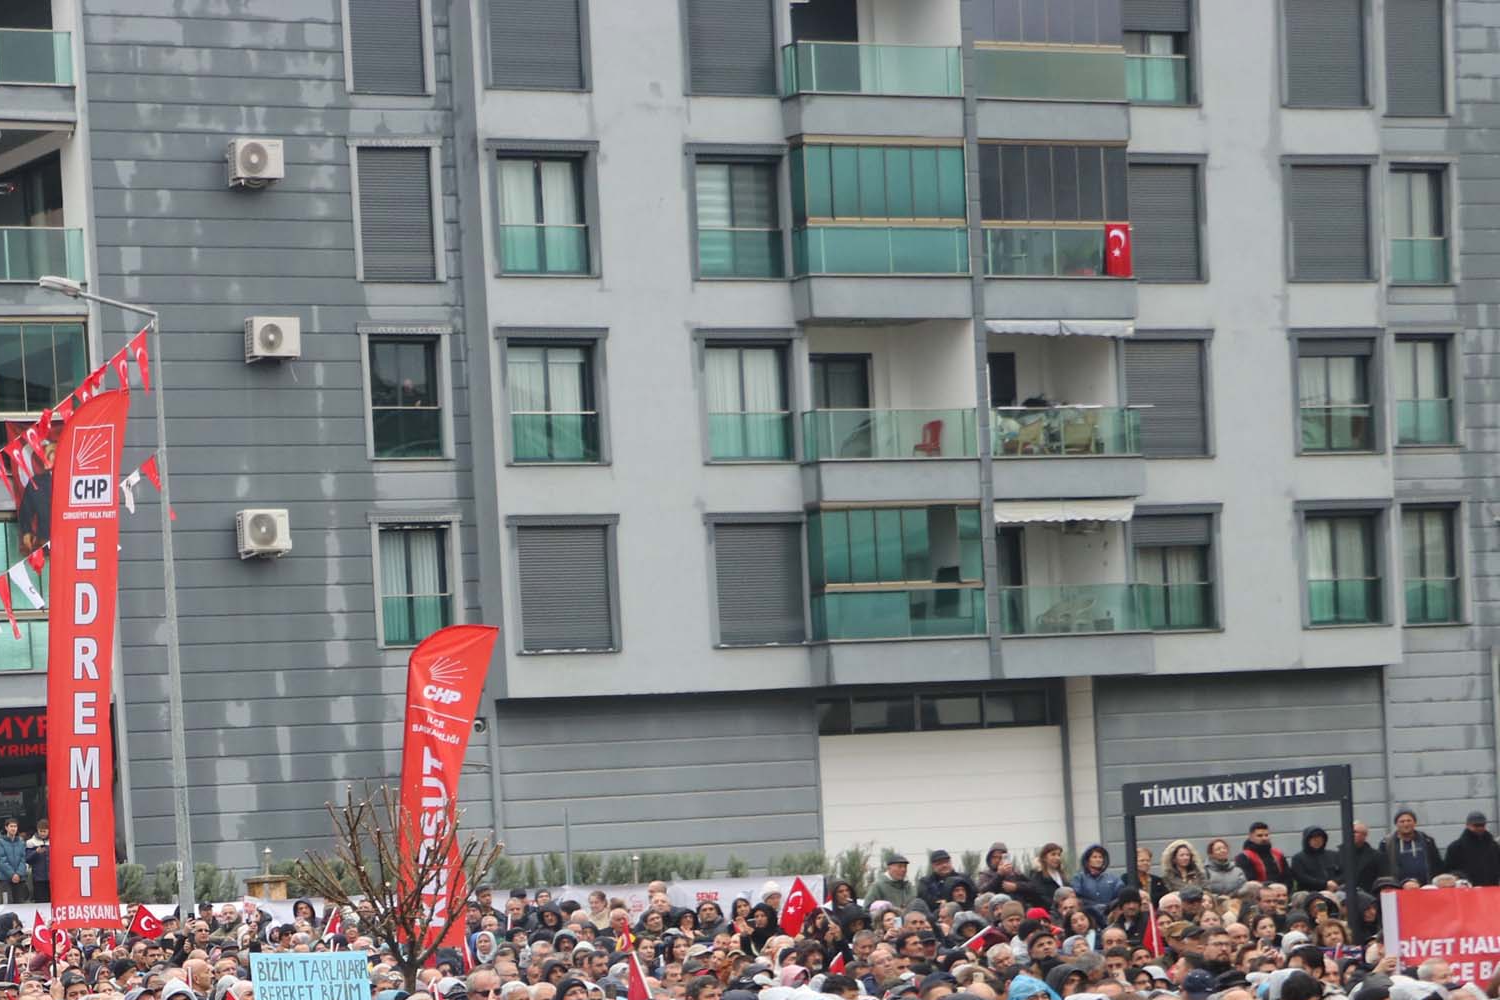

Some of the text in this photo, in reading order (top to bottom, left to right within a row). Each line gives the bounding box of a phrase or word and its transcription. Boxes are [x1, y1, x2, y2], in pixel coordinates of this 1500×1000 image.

[73, 478, 109, 501] CHP
[423, 685, 462, 704] CHP
[68, 526, 100, 898] EDREMİT
[1140, 770, 1326, 808] TİMUR KENT SİTESİ
[257, 957, 295, 982] BİZİM
